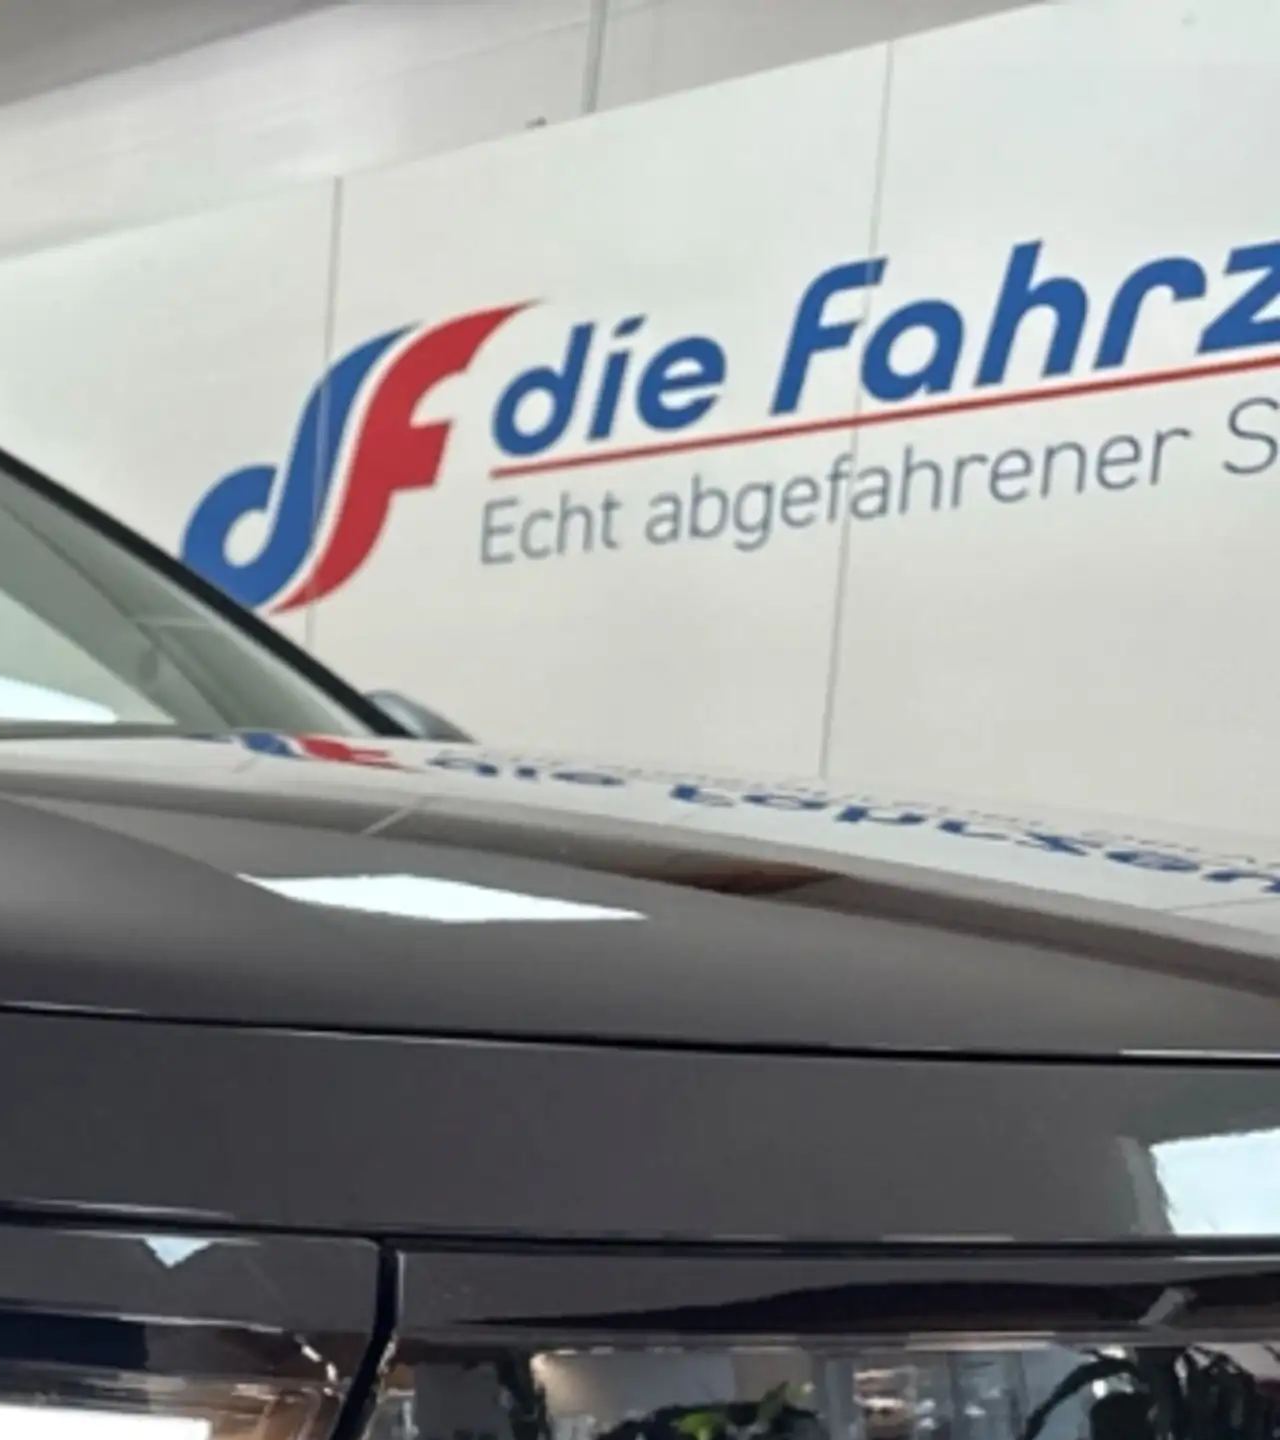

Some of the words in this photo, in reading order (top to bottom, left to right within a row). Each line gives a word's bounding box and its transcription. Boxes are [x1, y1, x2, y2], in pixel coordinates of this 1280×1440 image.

[491, 313, 727, 456] die
[480, 494, 621, 565] Echt
[644, 425, 1192, 552] abgefahrener
